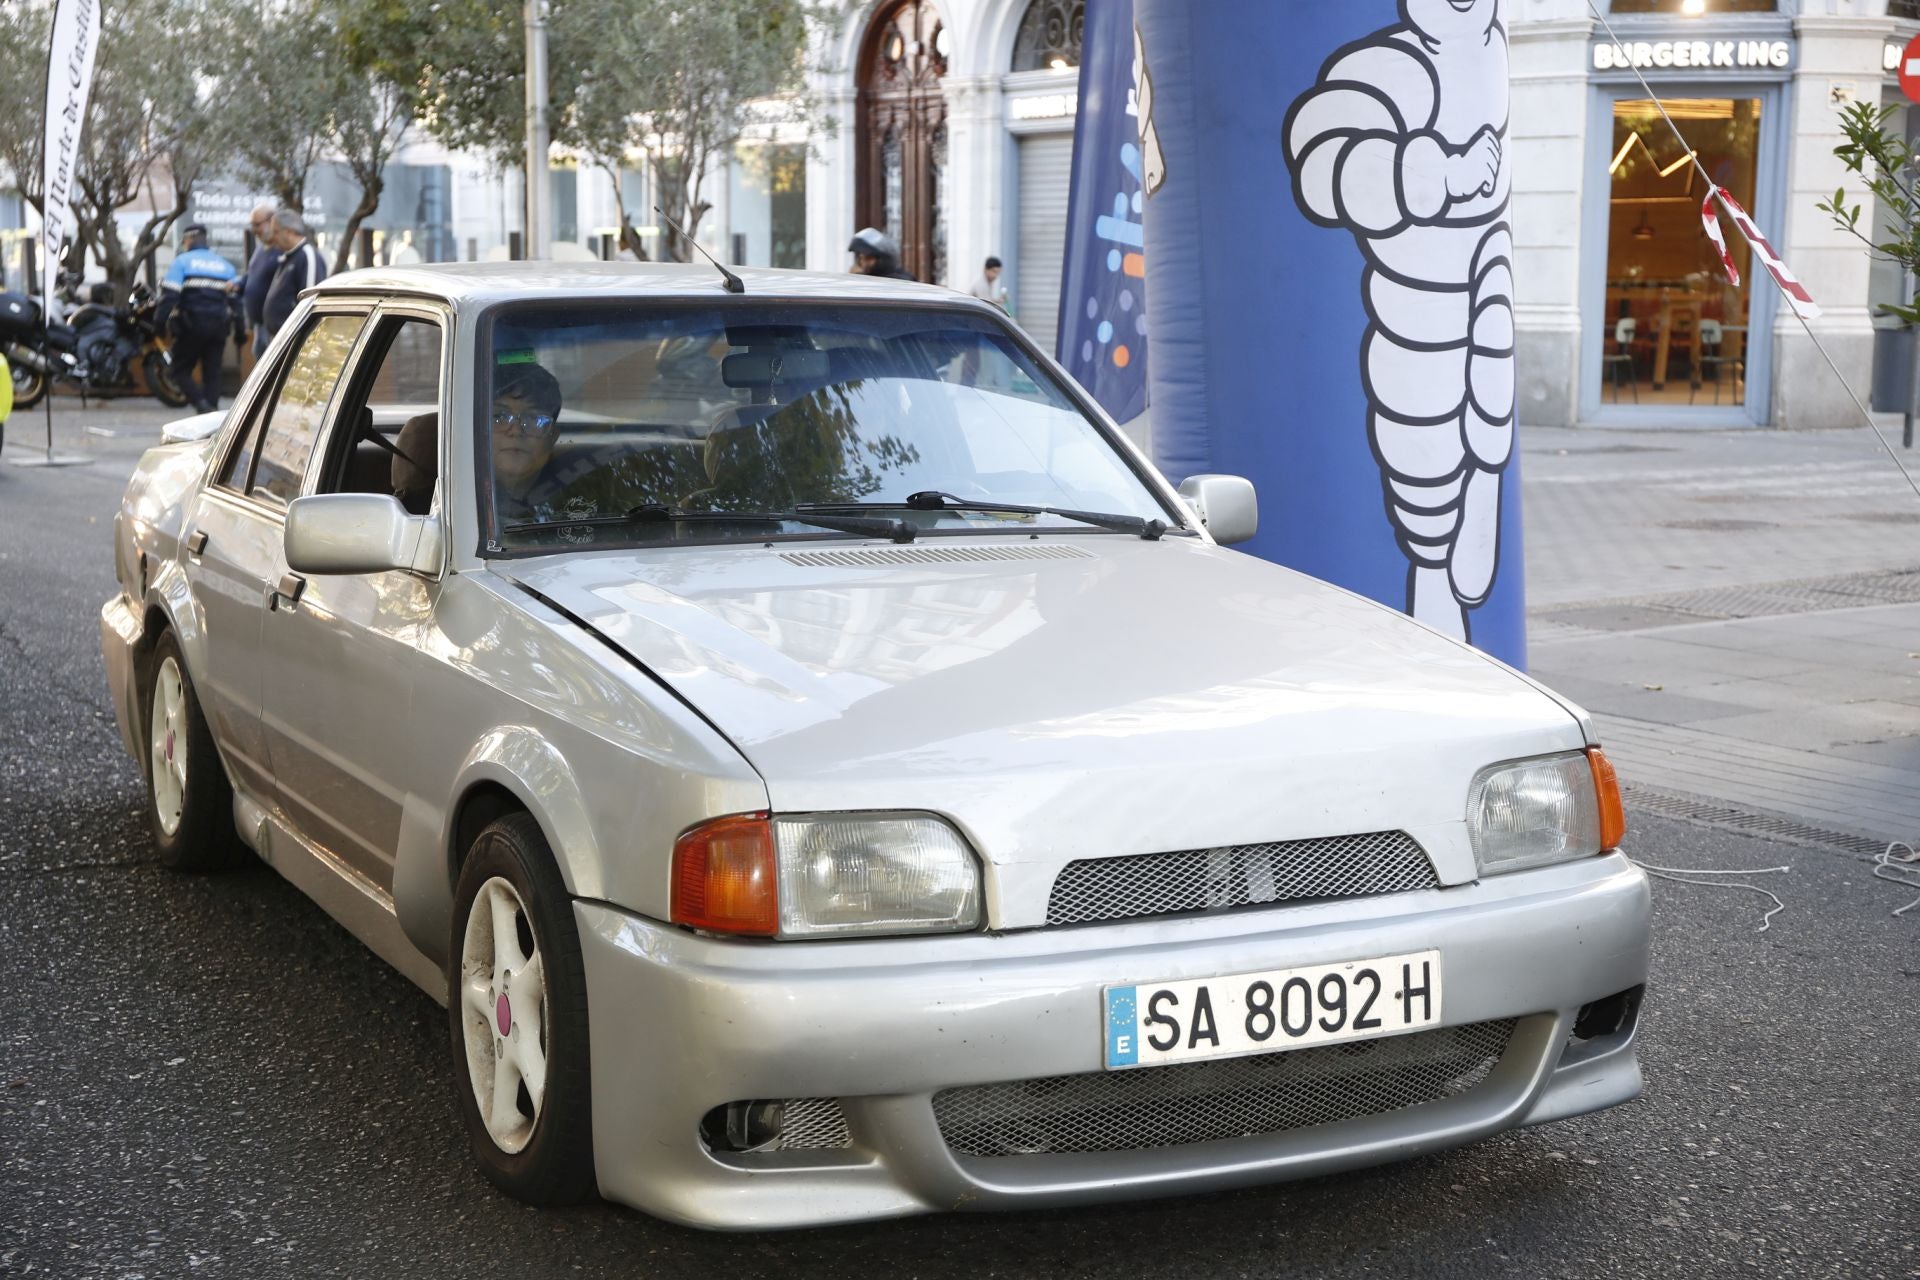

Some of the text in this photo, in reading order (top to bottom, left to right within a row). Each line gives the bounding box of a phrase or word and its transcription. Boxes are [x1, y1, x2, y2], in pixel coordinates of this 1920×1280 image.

[1594, 40, 1789, 69] BURGER KING
[50, 126, 72, 208] Norte
[63, 91, 78, 124] de
[192, 191, 231, 207] Todo
[1117, 961, 1431, 1054] E SA 8092 H
